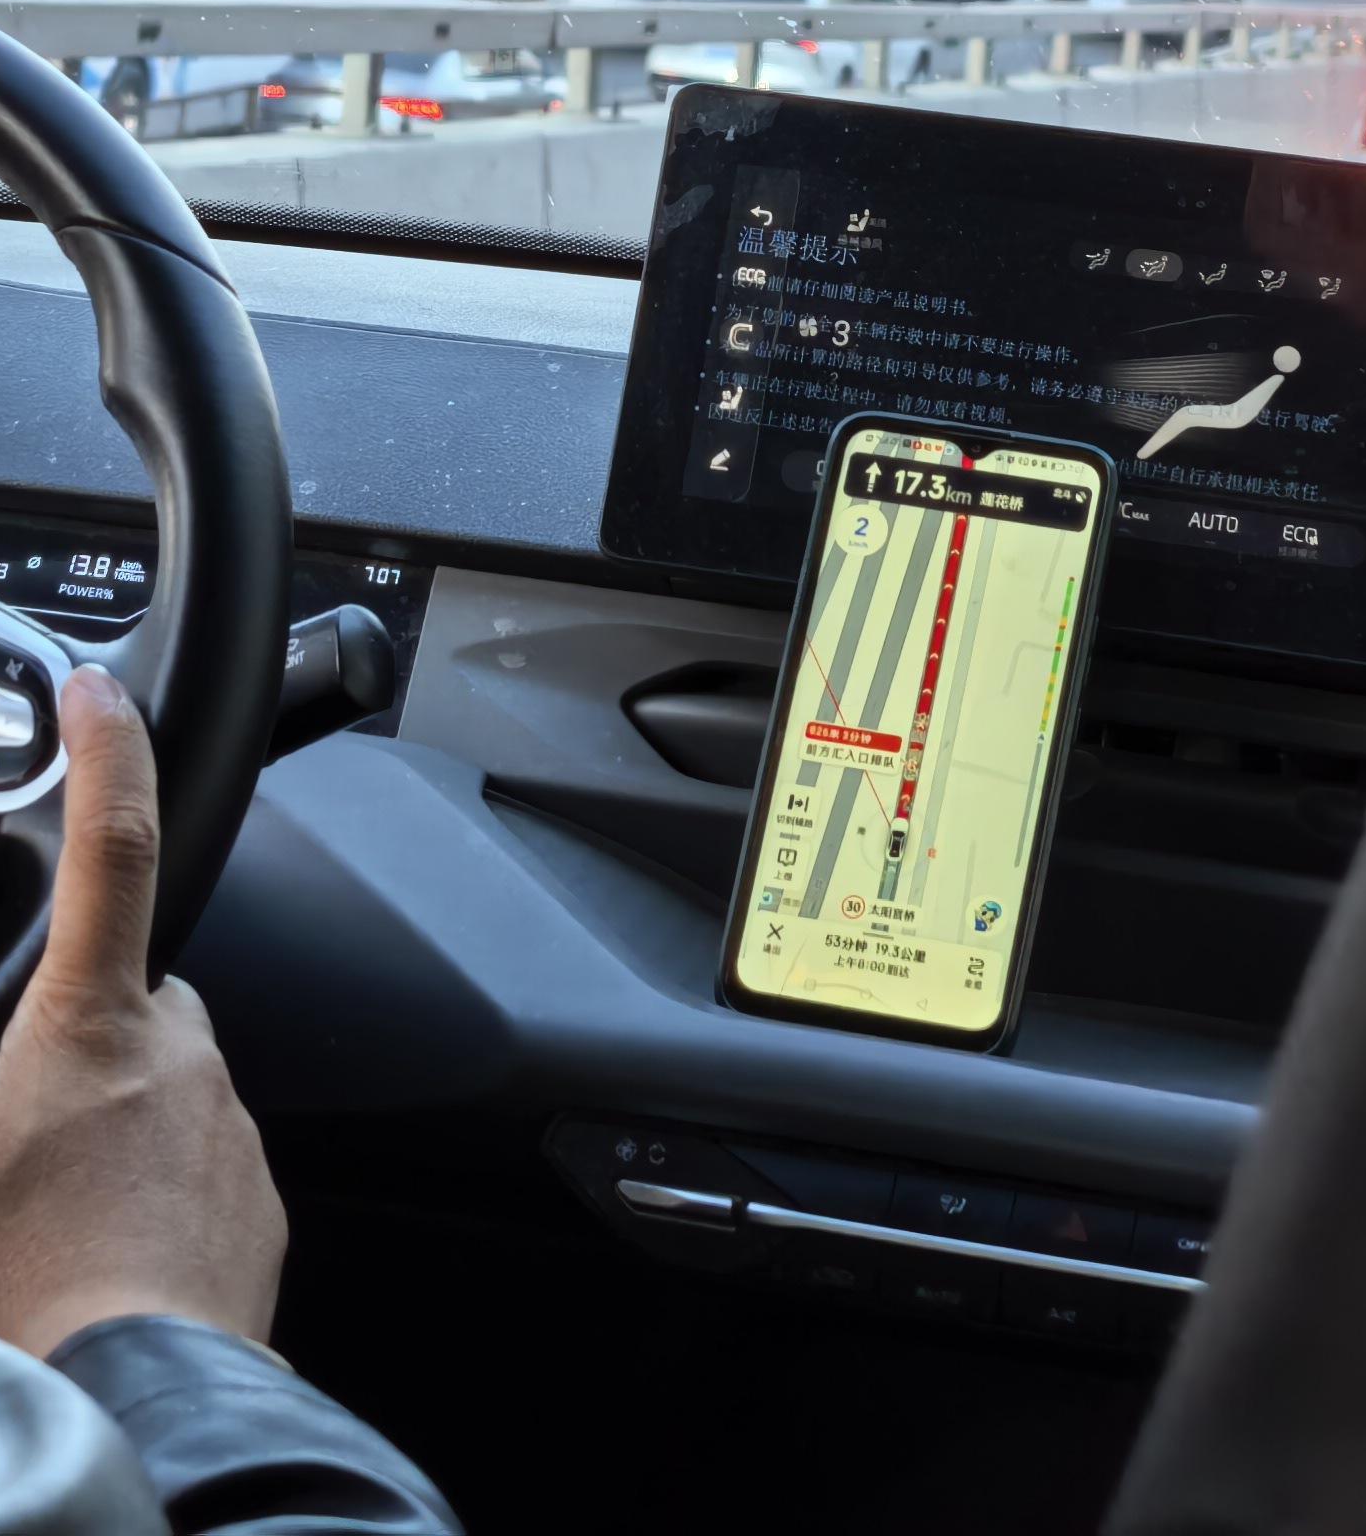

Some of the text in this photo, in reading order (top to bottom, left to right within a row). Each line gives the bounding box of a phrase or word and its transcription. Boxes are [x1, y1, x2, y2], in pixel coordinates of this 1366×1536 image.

[738, 226, 859, 265] 温馨提示
[831, 321, 851, 346] 3
[854, 517, 869, 536] 2
[1188, 512, 1238, 534] AUTO
[69, 554, 111, 578] 13.8
[59, 583, 114, 601] POWER%
[846, 900, 862, 914] 30
[824, 934, 926, 964] 53分钟 19.3公里
